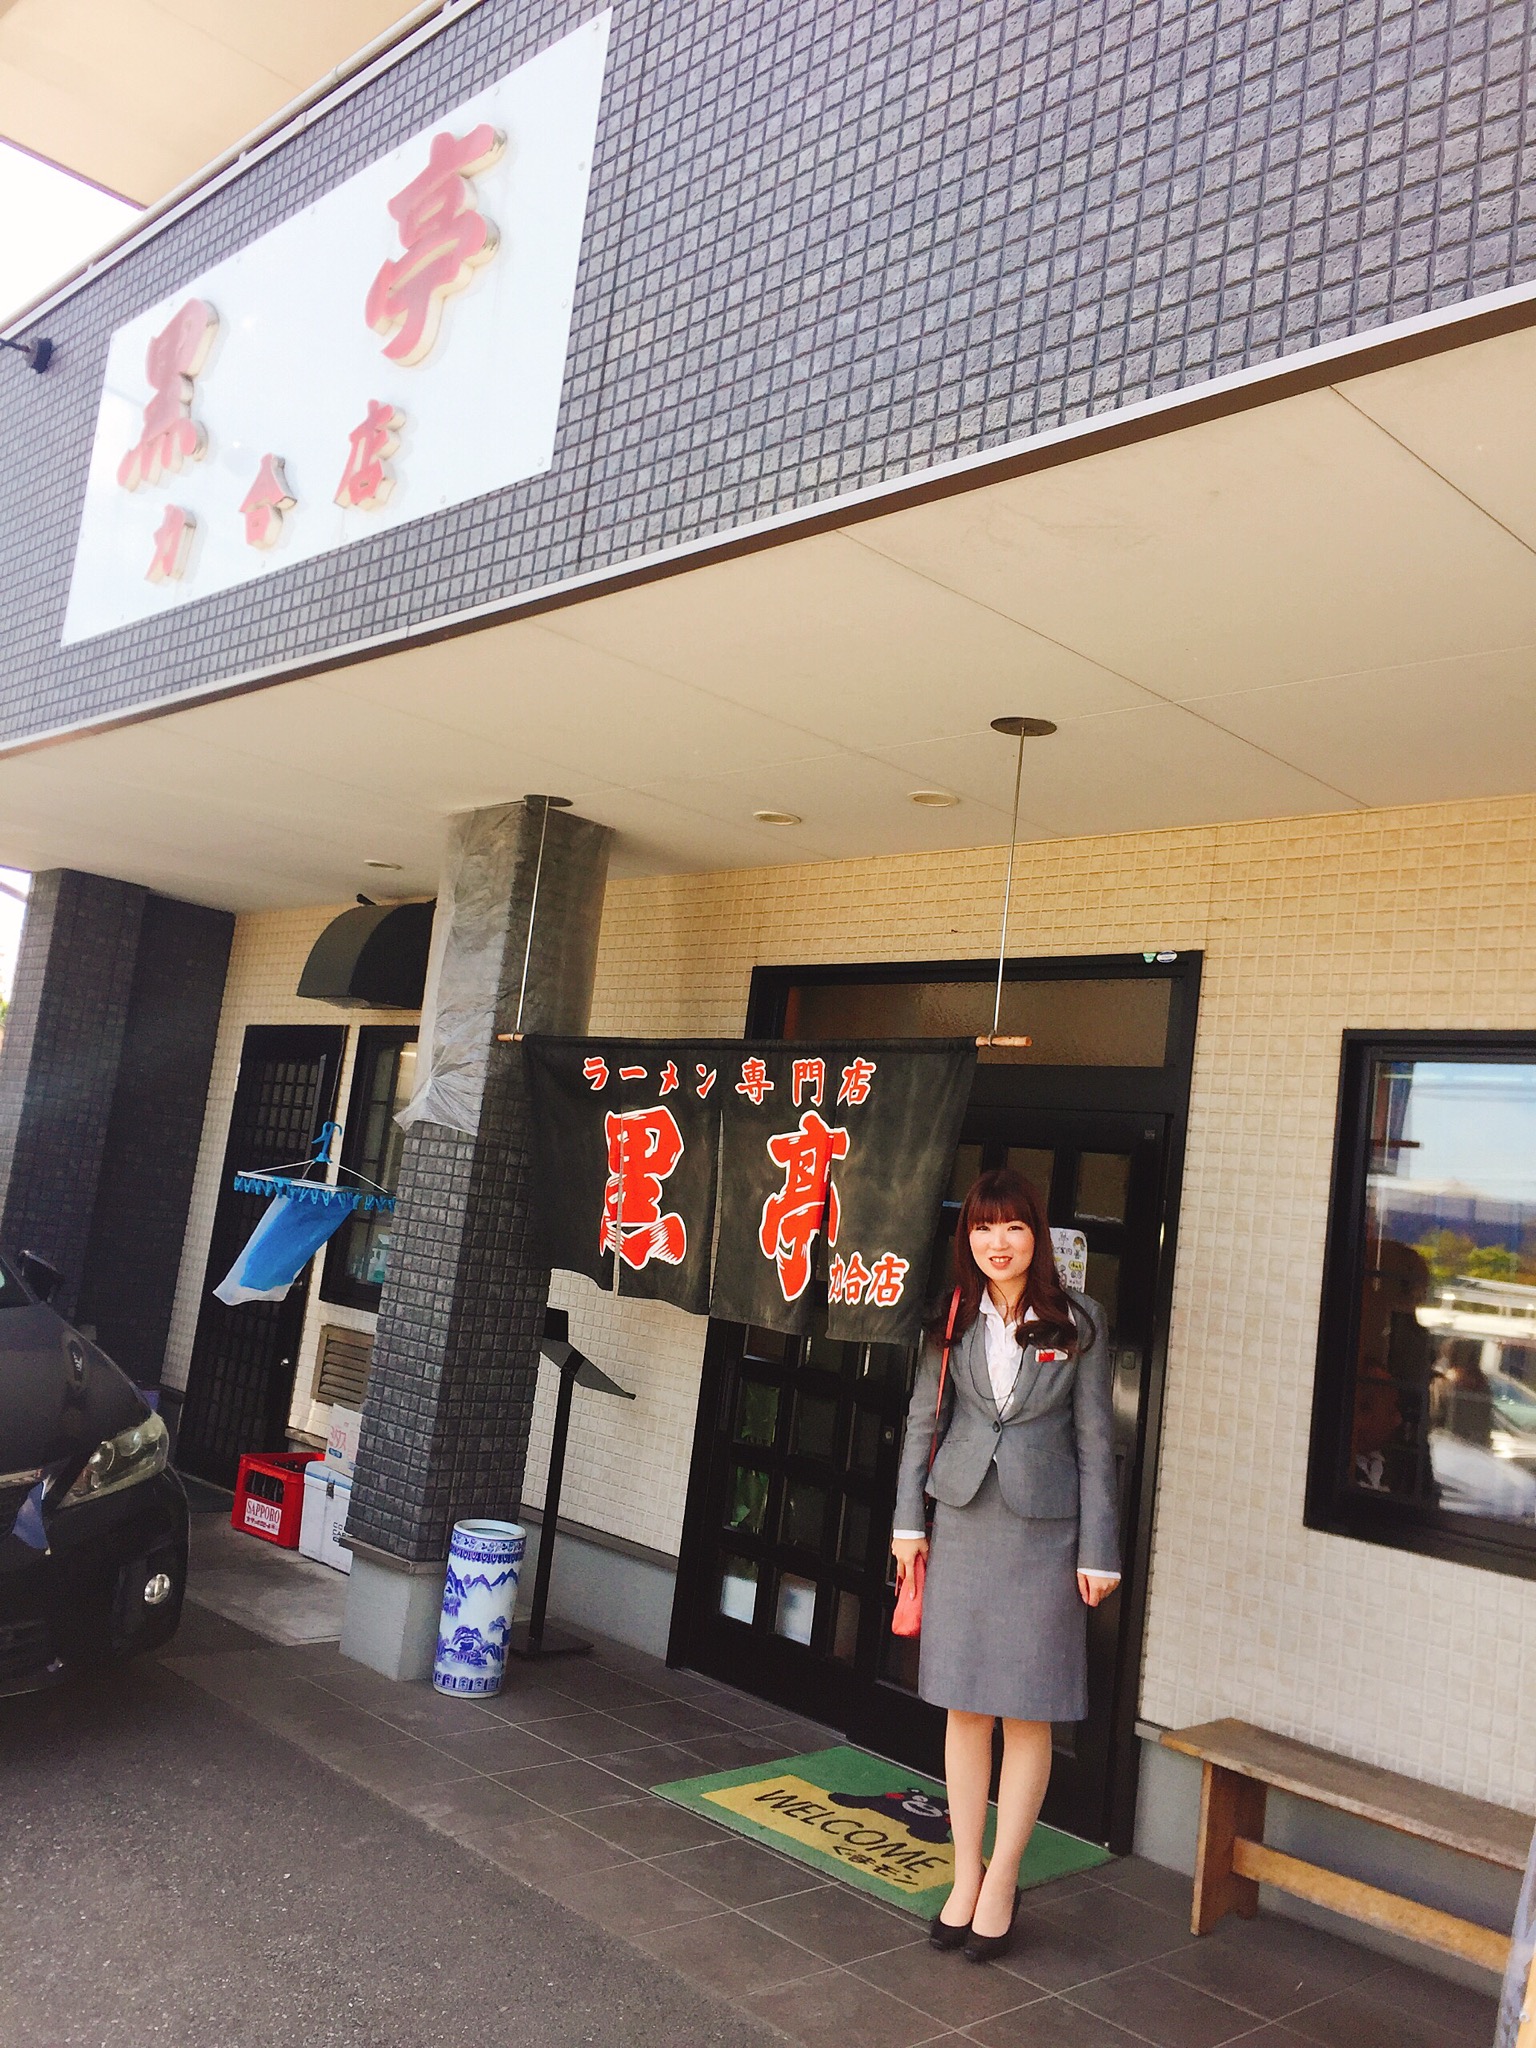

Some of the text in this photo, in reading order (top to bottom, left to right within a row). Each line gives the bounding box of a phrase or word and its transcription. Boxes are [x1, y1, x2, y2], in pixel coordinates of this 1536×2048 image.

[144, 399, 402, 585] 力合店
[583, 1056, 876, 1107] ラーメン専門店
[600, 1105, 851, 1301] 黒亭
[246, 1500, 280, 1524] SAPPORO
[754, 1789, 950, 1873] WELCOME
[833, 1846, 919, 1886] くまモン
